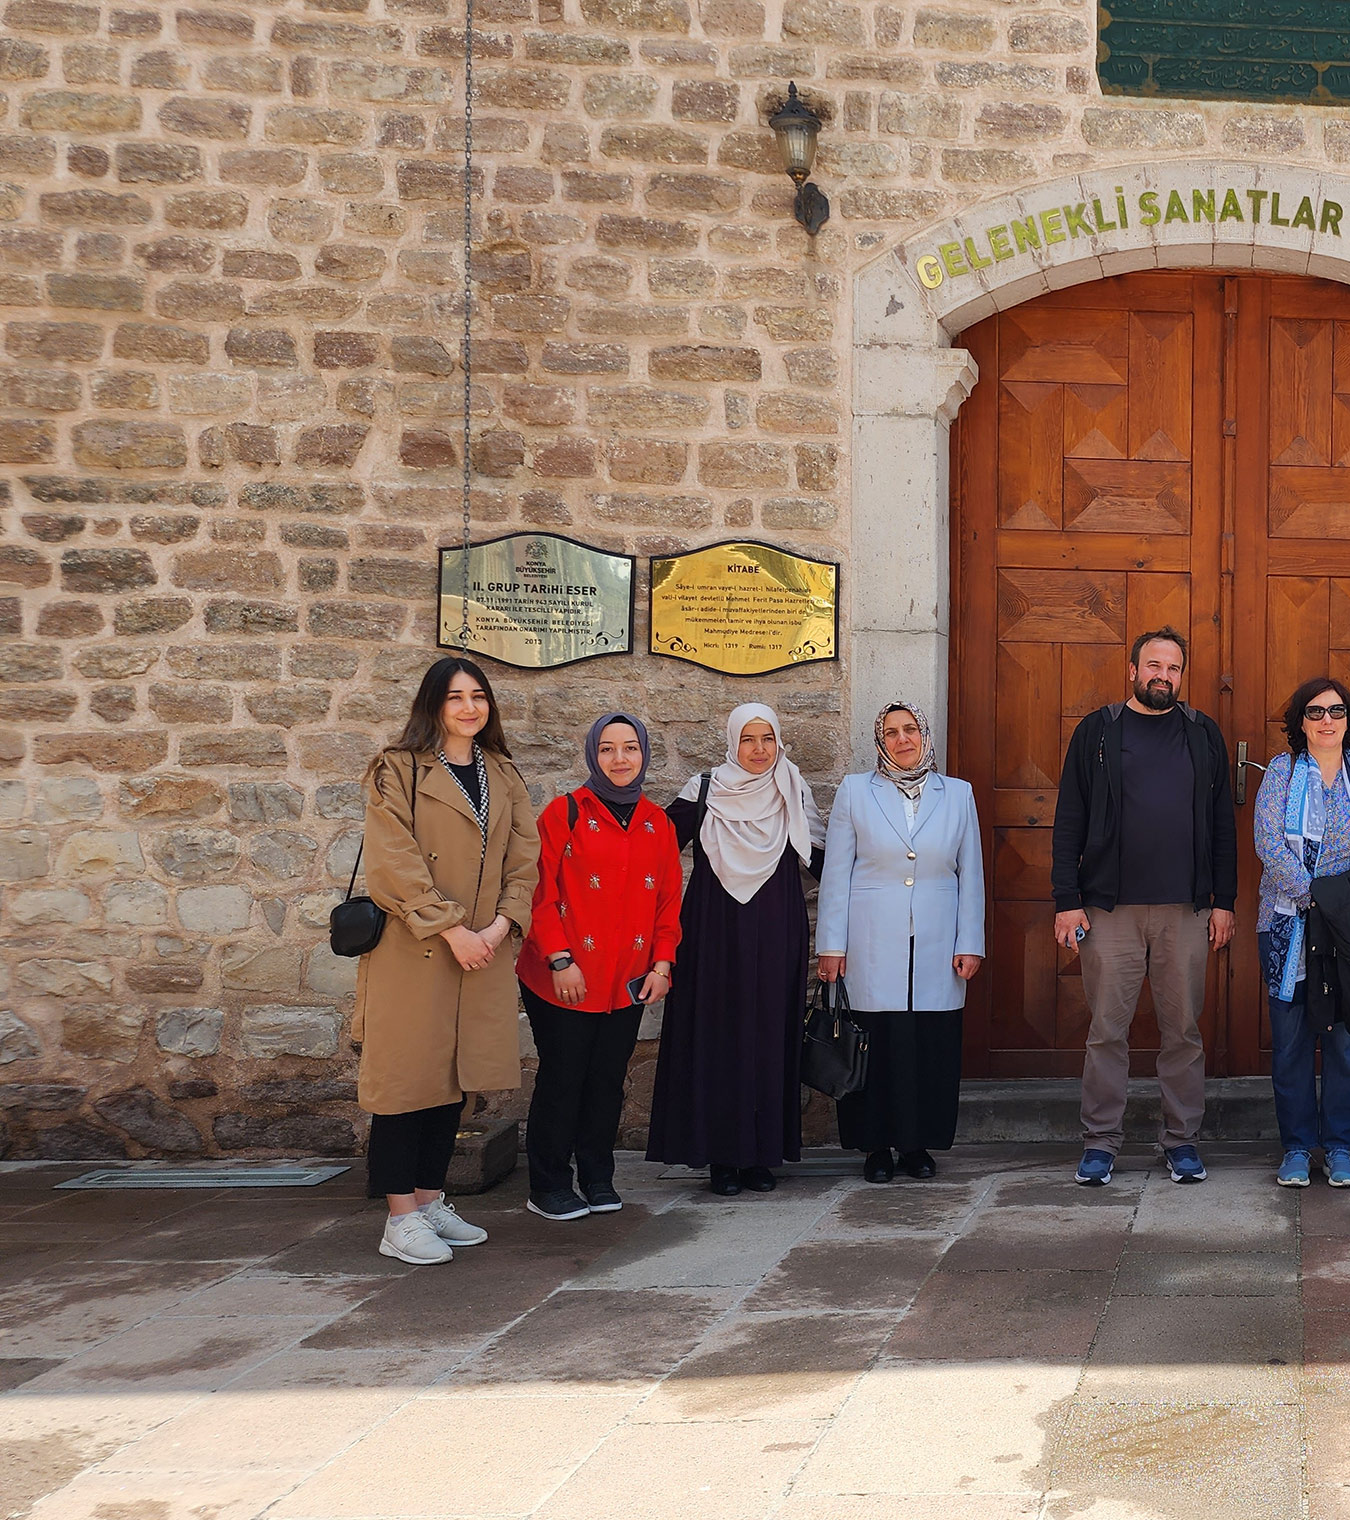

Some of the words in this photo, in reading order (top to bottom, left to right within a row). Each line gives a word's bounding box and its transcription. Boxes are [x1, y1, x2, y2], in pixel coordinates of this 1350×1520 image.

[916, 186, 1128, 289] GELENEKLİ
[1138, 188, 1342, 238] SANATLAR
[727, 564, 760, 574] KİTABE
[473, 582, 484, 591] II.
[488, 582, 520, 593] GRUP
[566, 586, 597, 596] ESER
[476, 624, 518, 632] TARAFINDAN
[552, 619, 593, 627] BELEDİYESİ
